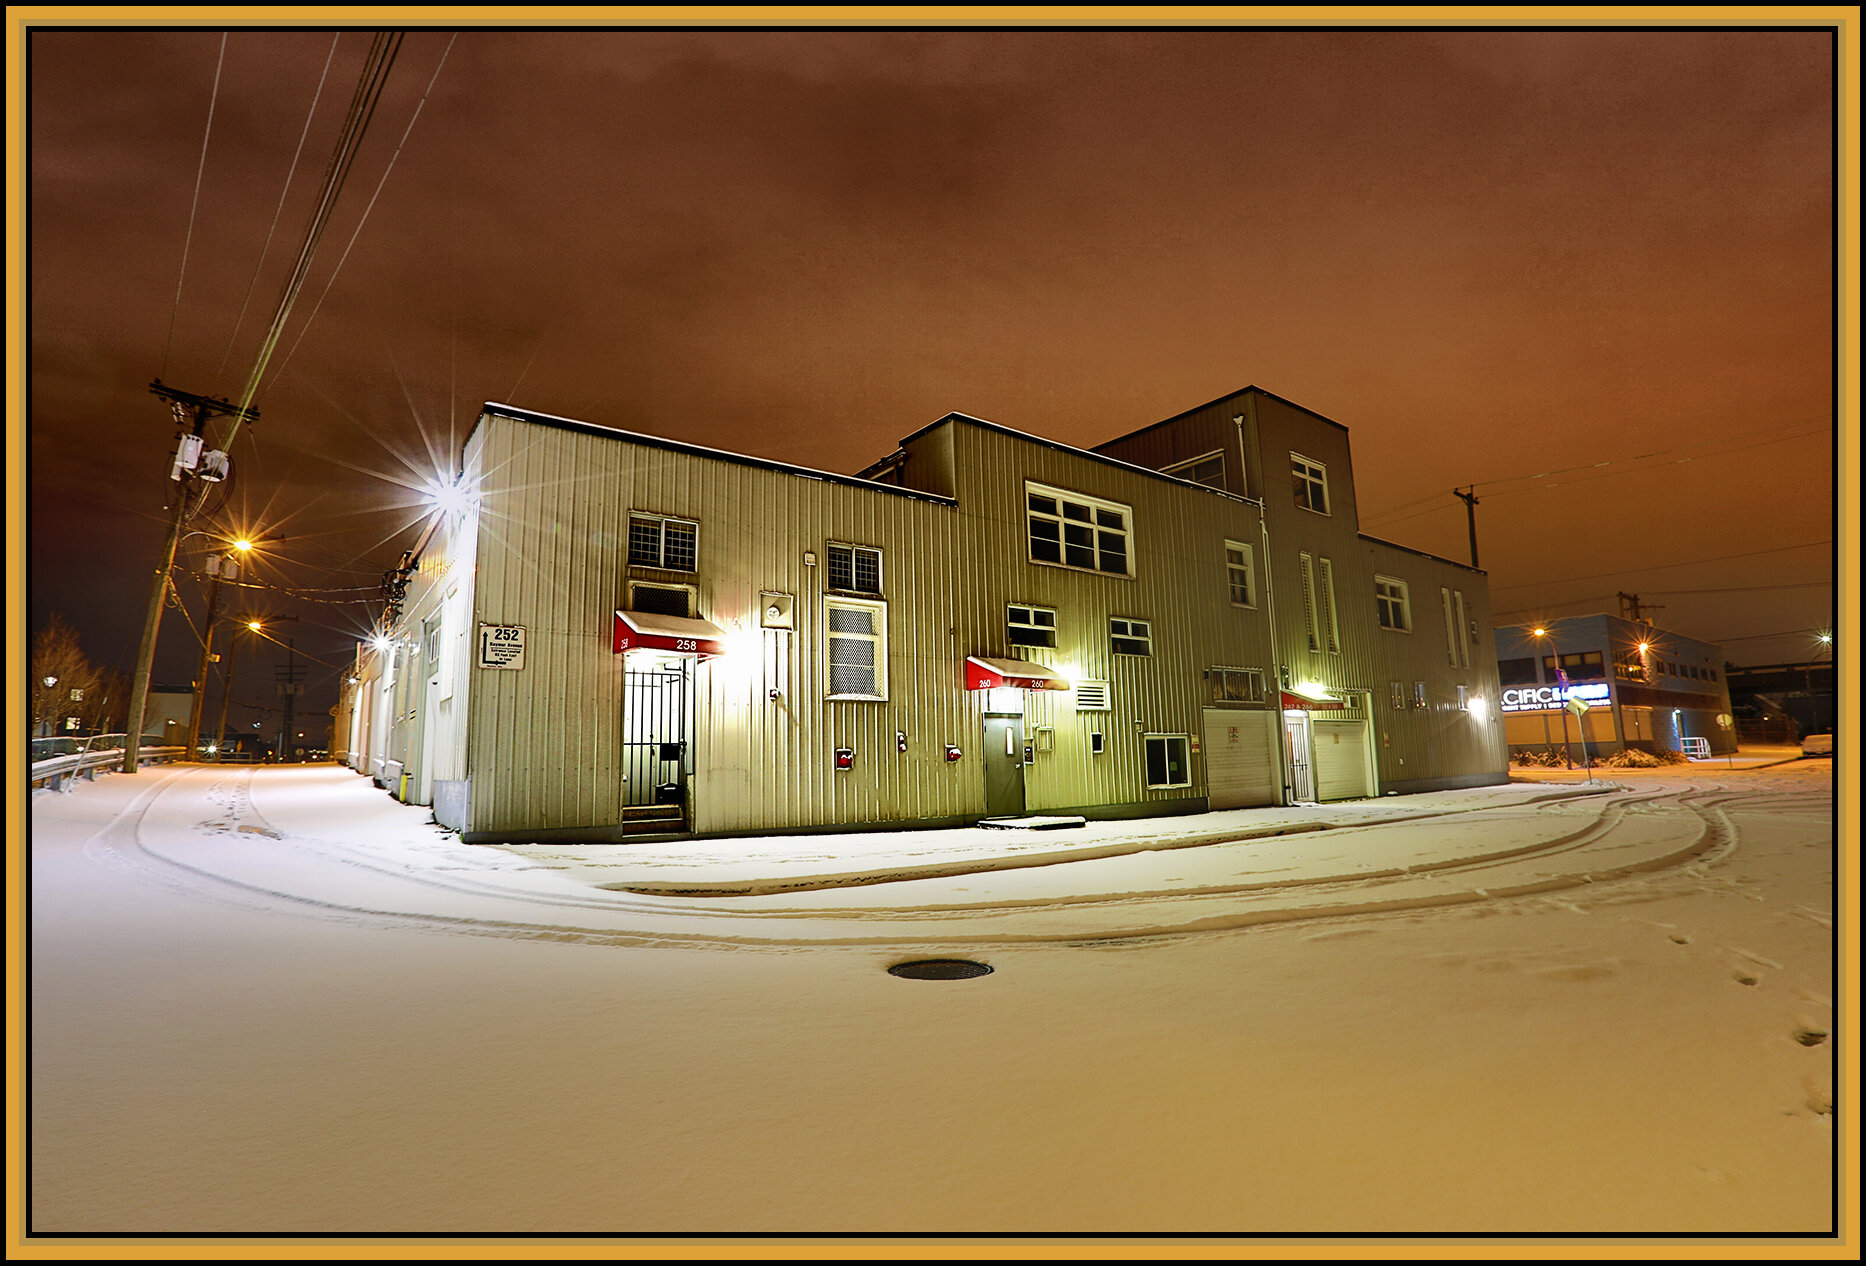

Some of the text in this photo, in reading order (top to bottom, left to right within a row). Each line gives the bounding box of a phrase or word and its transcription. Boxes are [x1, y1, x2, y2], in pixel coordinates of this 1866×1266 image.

[495, 628, 519, 641] 252
[620, 638, 629, 650] 258
[676, 639, 697, 651] 258
[979, 679, 991, 688] 260
[1031, 679, 1044, 688] 260
[1500, 687, 1552, 705] CIFIC
